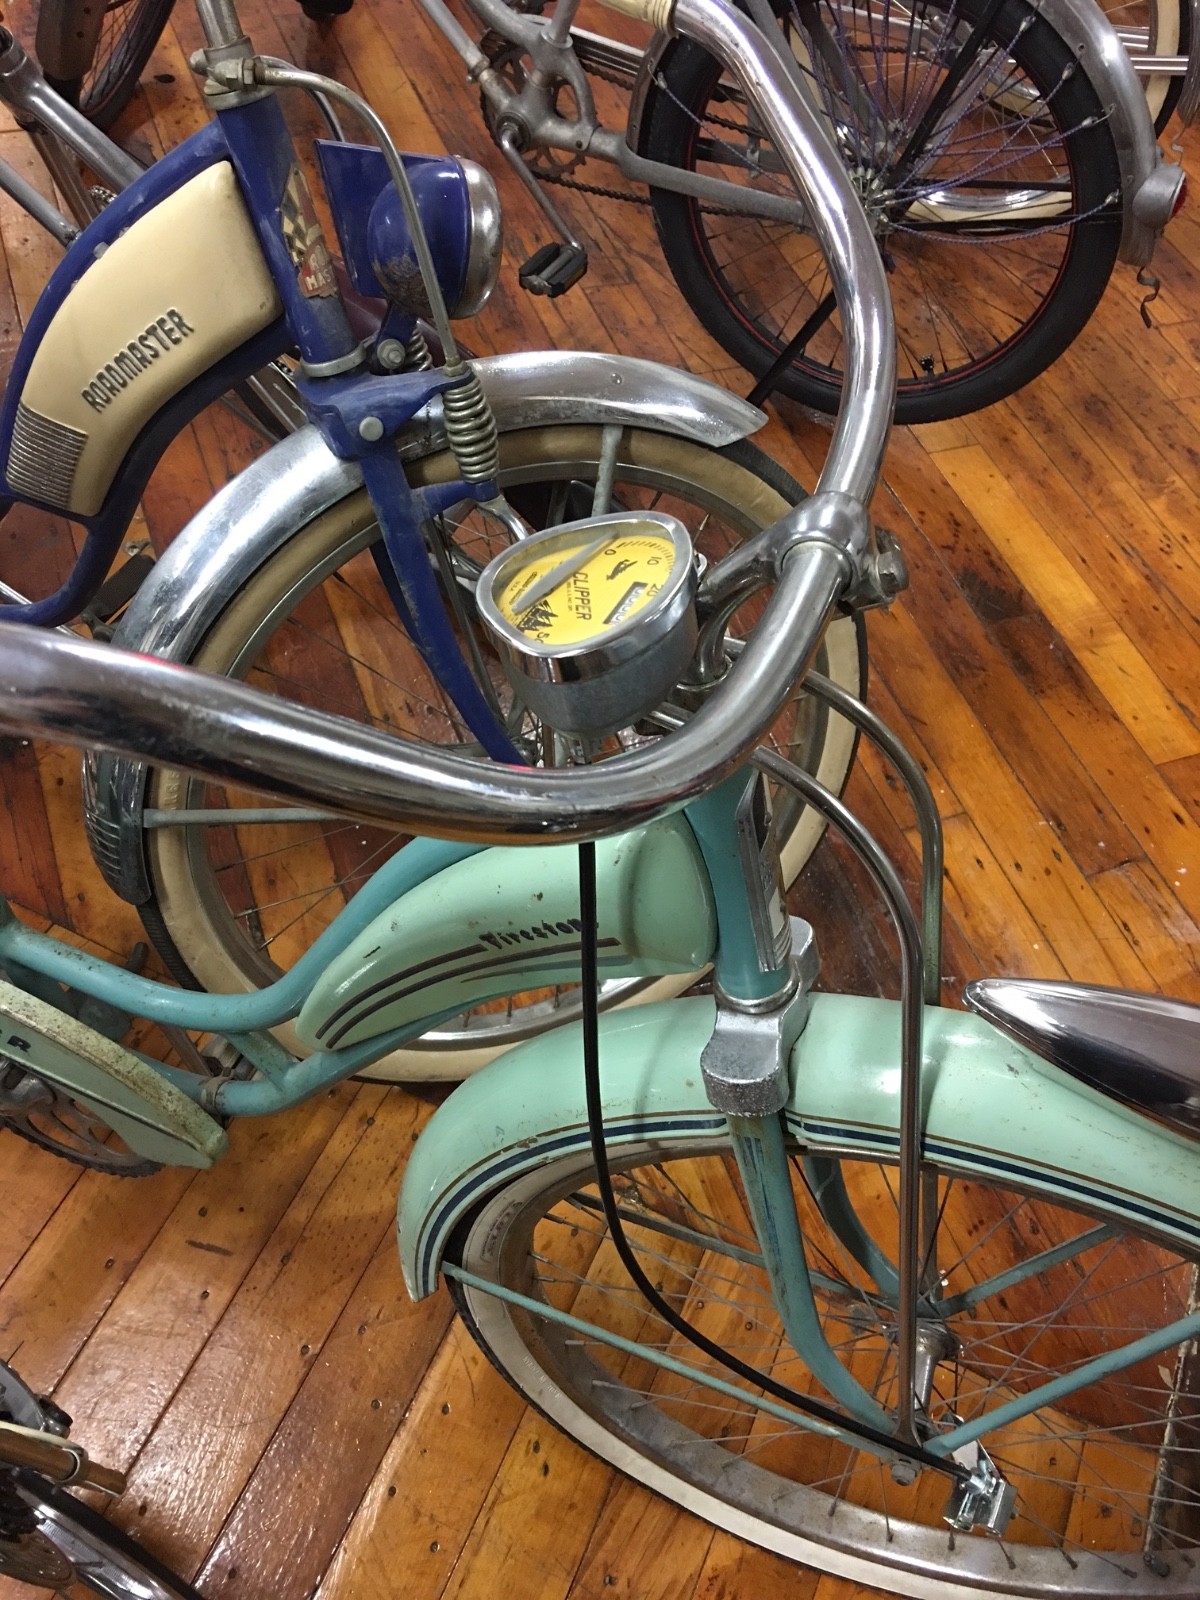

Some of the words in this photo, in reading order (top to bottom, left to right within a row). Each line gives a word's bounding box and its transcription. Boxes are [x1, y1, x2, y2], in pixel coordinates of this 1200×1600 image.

[82, 308, 194, 413] ROADMASTER
[572, 572, 592, 621] CLIPPER
[479, 919, 599, 949] Fireston
